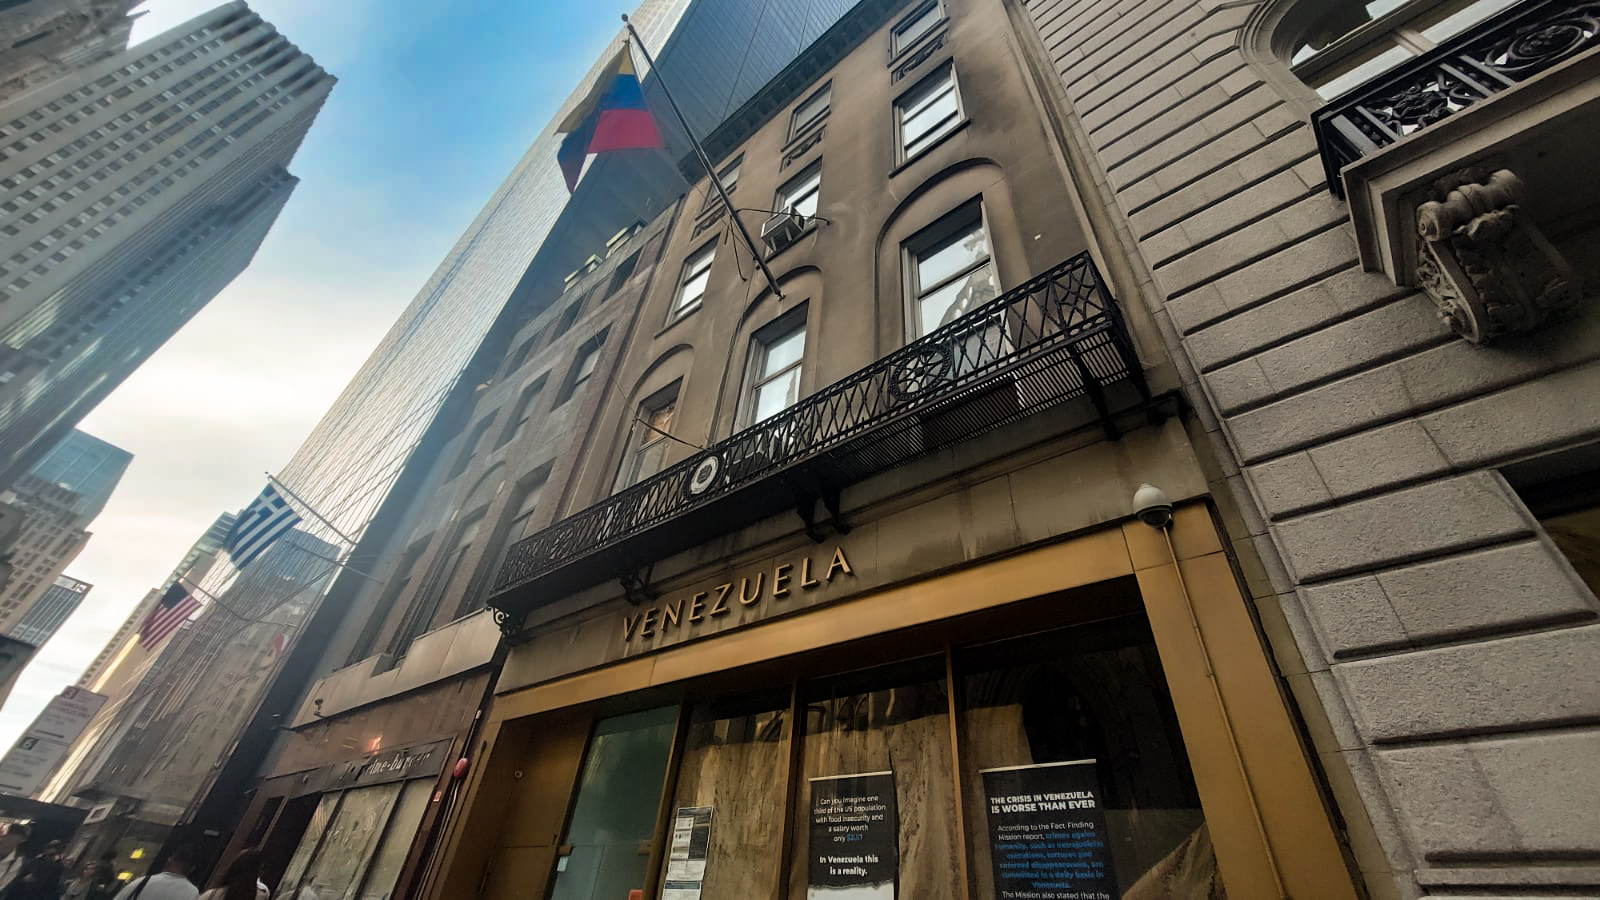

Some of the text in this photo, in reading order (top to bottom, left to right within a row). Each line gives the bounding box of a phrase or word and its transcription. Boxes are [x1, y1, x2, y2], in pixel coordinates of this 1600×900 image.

[623, 546, 851, 641] VENEZUELA
[831, 798, 842, 806] you
[843, 796, 866, 804] imagine
[1006, 795, 1032, 803] CRISIS
[1033, 794, 1042, 802] IN
[1043, 791, 1094, 801] VENEZUELA
[853, 804, 886, 813] population
[991, 799, 1096, 814] IS WORSE THAN EVER
[828, 815, 842, 823] food
[842, 815, 871, 823] insecurity
[833, 825, 850, 833] salary
[997, 823, 1030, 832] According
[833, 835, 846, 843] only
[1023, 833, 1045, 841] report,
[819, 854, 879, 864] In Venezuela this
[829, 866, 836, 875] is
[842, 866, 868, 877] reality.
[1001, 890, 1110, 900] The Mission also stated that the
